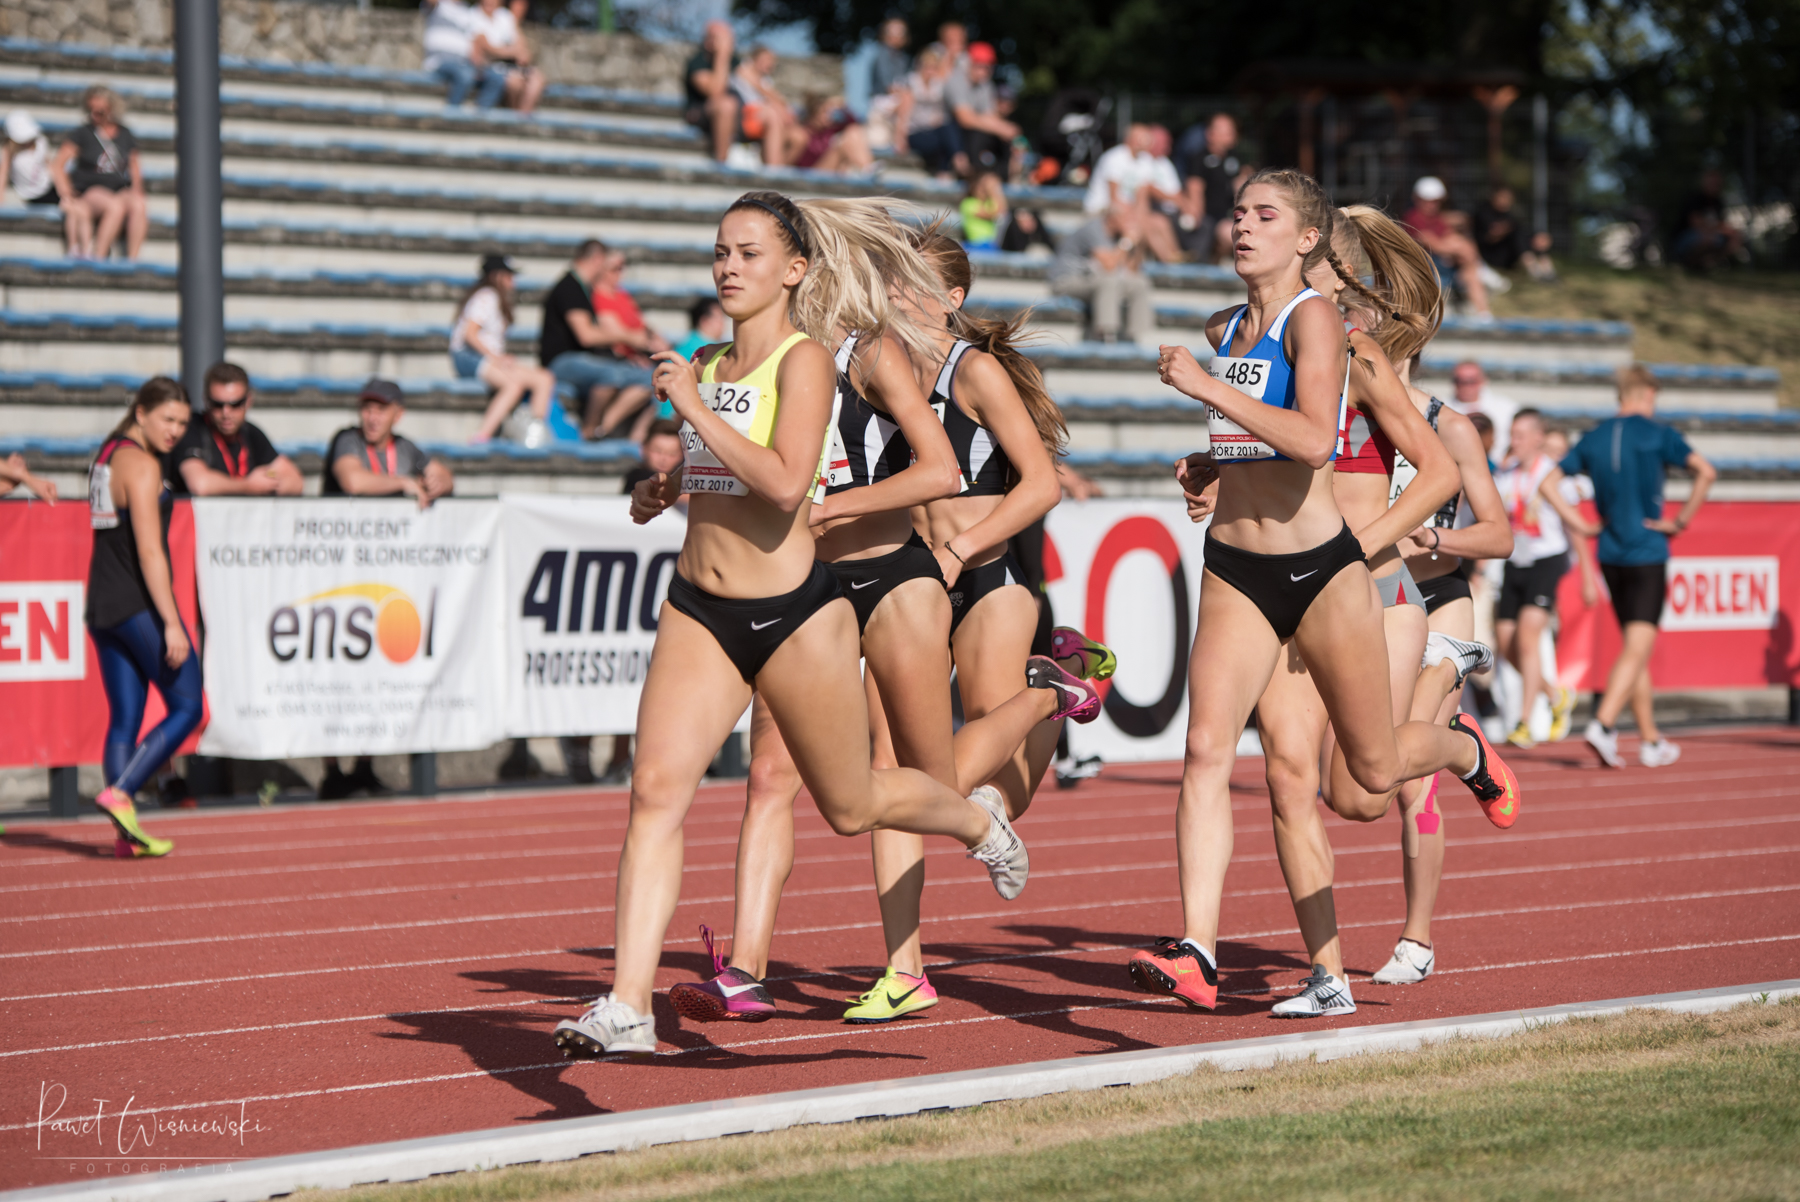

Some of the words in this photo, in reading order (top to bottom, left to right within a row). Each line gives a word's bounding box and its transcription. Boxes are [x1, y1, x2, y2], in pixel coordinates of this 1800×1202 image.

[1225, 362, 1264, 386] 485
[712, 387, 752, 414] 526
[1236, 446, 1259, 457] 2019
[708, 479, 734, 492] 2019
[294, 518, 412, 541] PRODUCENT
[209, 541, 345, 568] KOLEKTORÓW
[1671, 573, 1769, 614] ORLEN
[268, 586, 438, 665] ensol
